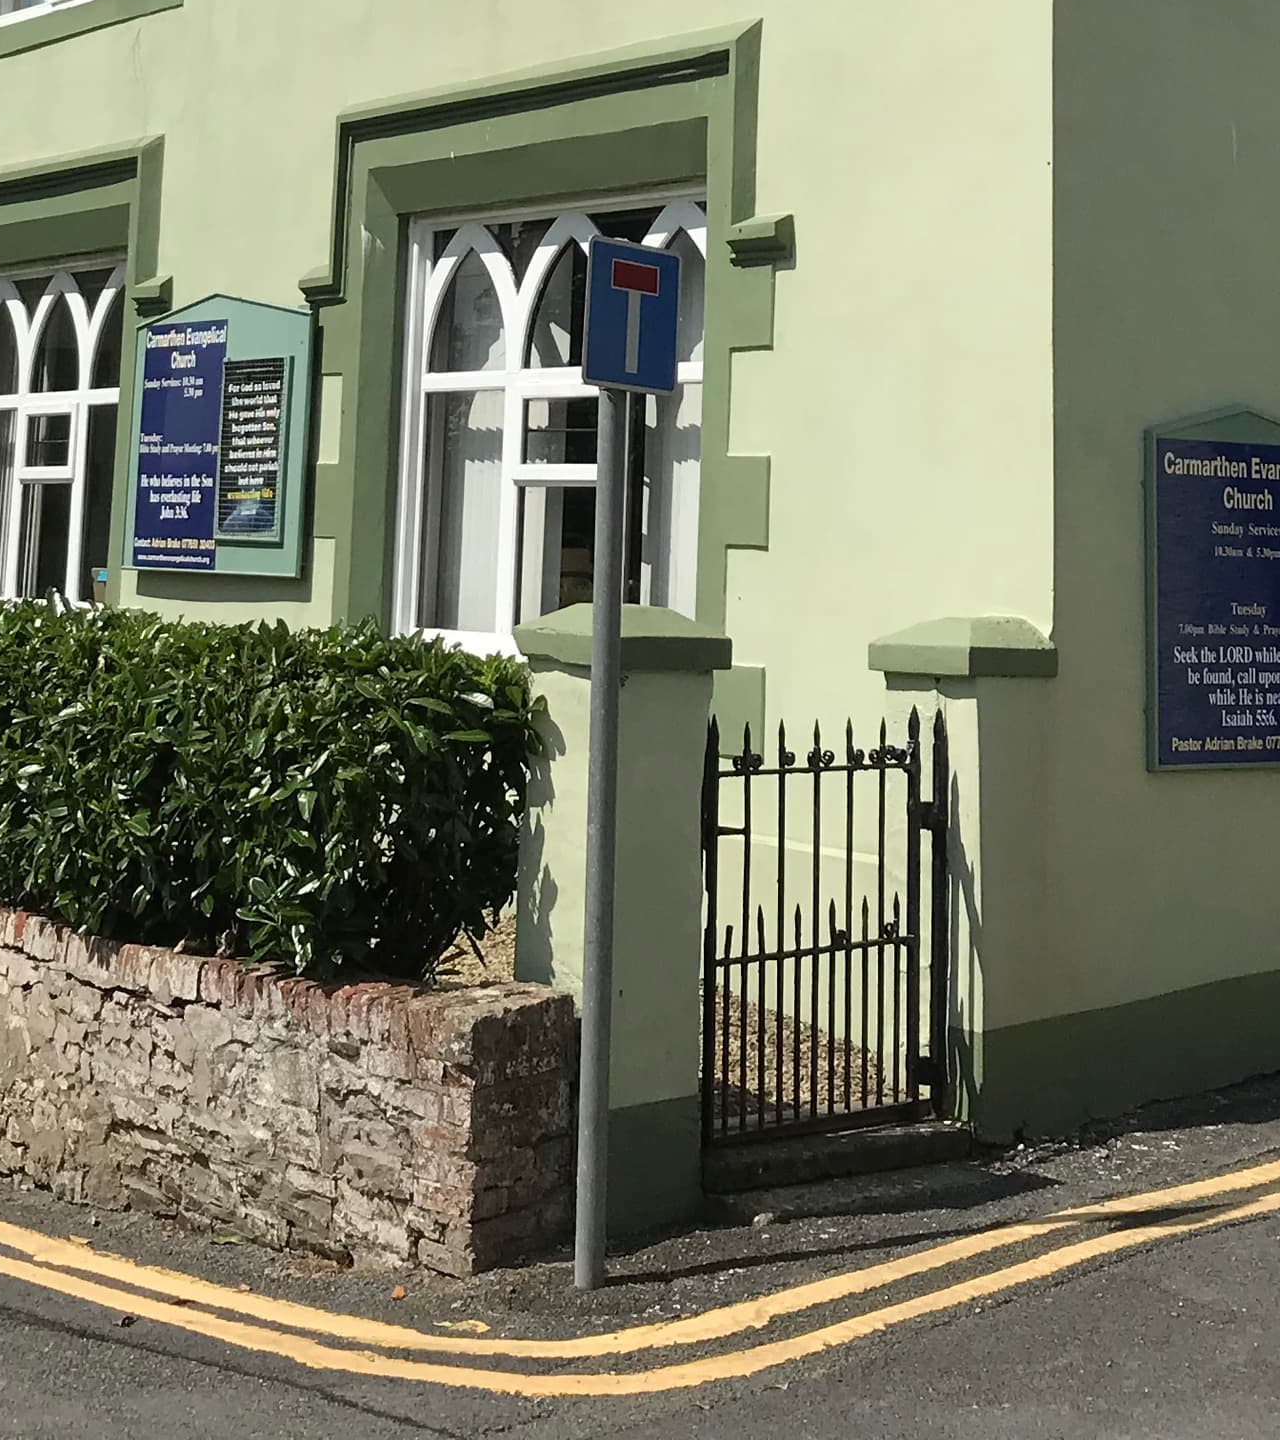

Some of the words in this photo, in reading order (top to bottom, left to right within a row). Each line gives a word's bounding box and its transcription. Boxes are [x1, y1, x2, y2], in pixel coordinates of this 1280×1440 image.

[147, 329, 185, 348] Carmarthen
[186, 325, 227, 348] Evangelical
[171, 350, 196, 369] Church
[228, 383, 240, 392] For
[241, 382, 253, 392] God
[262, 380, 280, 390] loved
[263, 394, 277, 404] that
[228, 410, 238, 419] He
[239, 411, 254, 421] gave
[266, 407, 280, 419] only
[232, 423, 261, 434] begotten
[1164, 452, 1247, 478] Carmarthen
[141, 474, 148, 487] He
[149, 474, 160, 487] who
[161, 474, 182, 487] believes
[184, 474, 190, 487] in
[191, 474, 200, 487] the
[201, 474, 213, 487] Son
[150, 490, 160, 502] has
[191, 490, 201, 503] life
[1223, 486, 1273, 510] Church
[160, 506, 174, 520] John
[1211, 521, 1244, 538] Sunday
[1246, 547, 1253, 557] &
[1230, 602, 1267, 618] Tuesday
[1208, 624, 1227, 634] Bible
[1230, 624, 1249, 637] Study
[1253, 624, 1260, 634] &
[1173, 646, 1198, 664] Seek
[1200, 647, 1217, 663] the
[1220, 646, 1253, 663] LORD
[1188, 668, 1200, 685] be
[1203, 667, 1236, 686] found,
[1237, 668, 1256, 684] call
[1208, 688, 1237, 706] while
[1239, 688, 1253, 706] He
[1255, 689, 1264, 705] is
[1222, 710, 1253, 727] Isaiah
[1172, 737, 1202, 752] Pastor
[1204, 737, 1235, 751] Adrian
[1237, 736, 1263, 751] Brake
